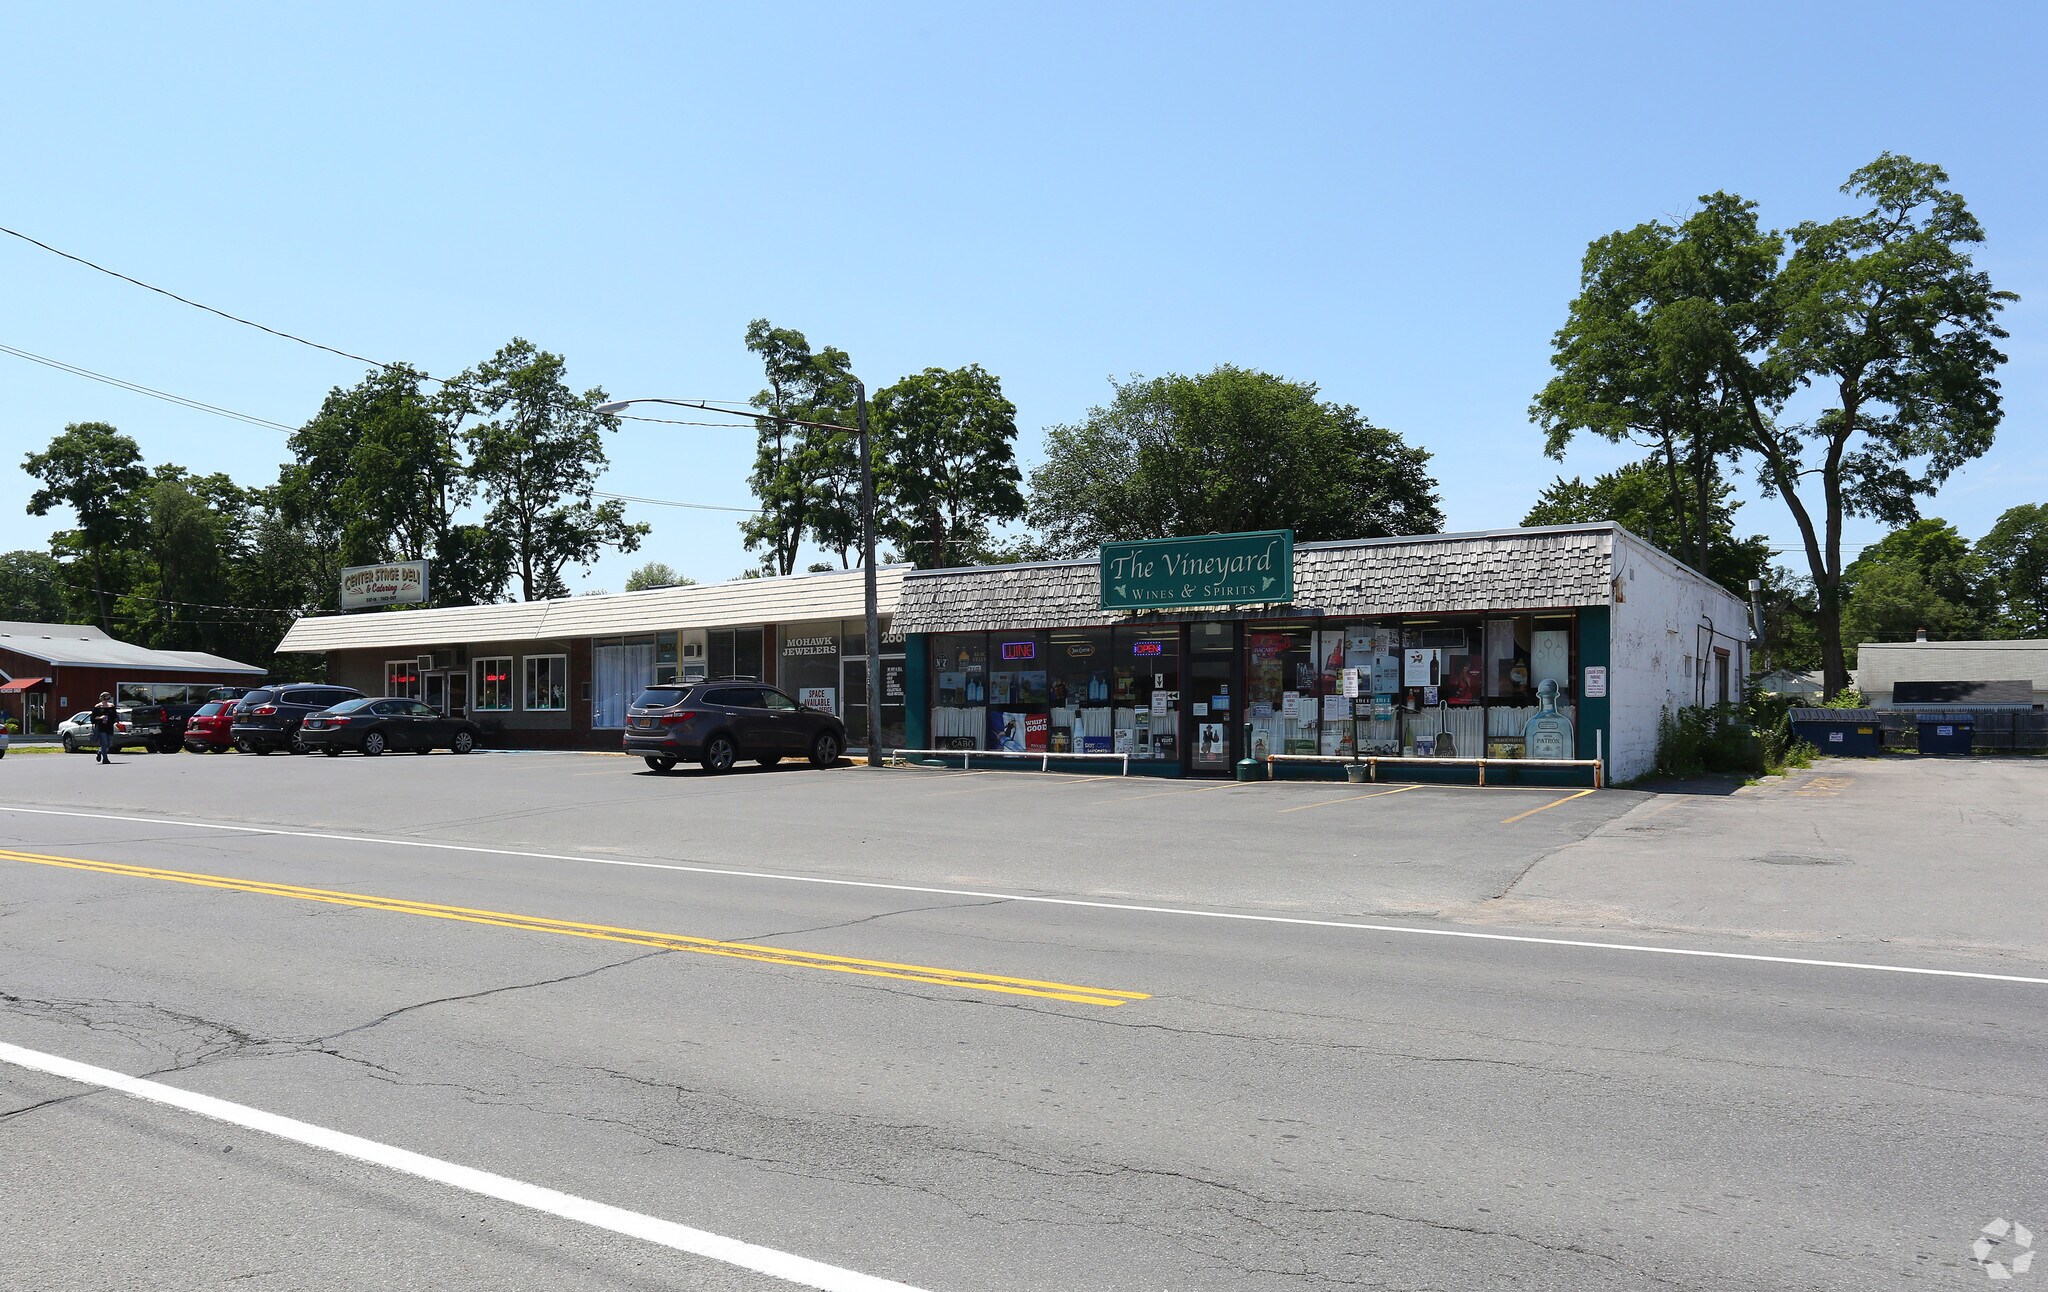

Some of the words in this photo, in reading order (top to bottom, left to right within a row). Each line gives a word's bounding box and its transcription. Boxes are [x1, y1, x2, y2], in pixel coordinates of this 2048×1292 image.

[1110, 550, 1153, 579] The
[1161, 541, 1278, 586] Vineyard
[344, 570, 374, 590] CENTER
[376, 568, 400, 582] STAGE
[402, 568, 420, 585] DELI
[366, 584, 371, 593] &
[372, 583, 398, 594] Catering
[1181, 584, 1197, 598] &
[786, 637, 832, 647] MOHAWK
[782, 646, 837, 656] JEWELERS
[1004, 645, 1032, 658] WINE
[1138, 645, 1158, 653] OPEN
